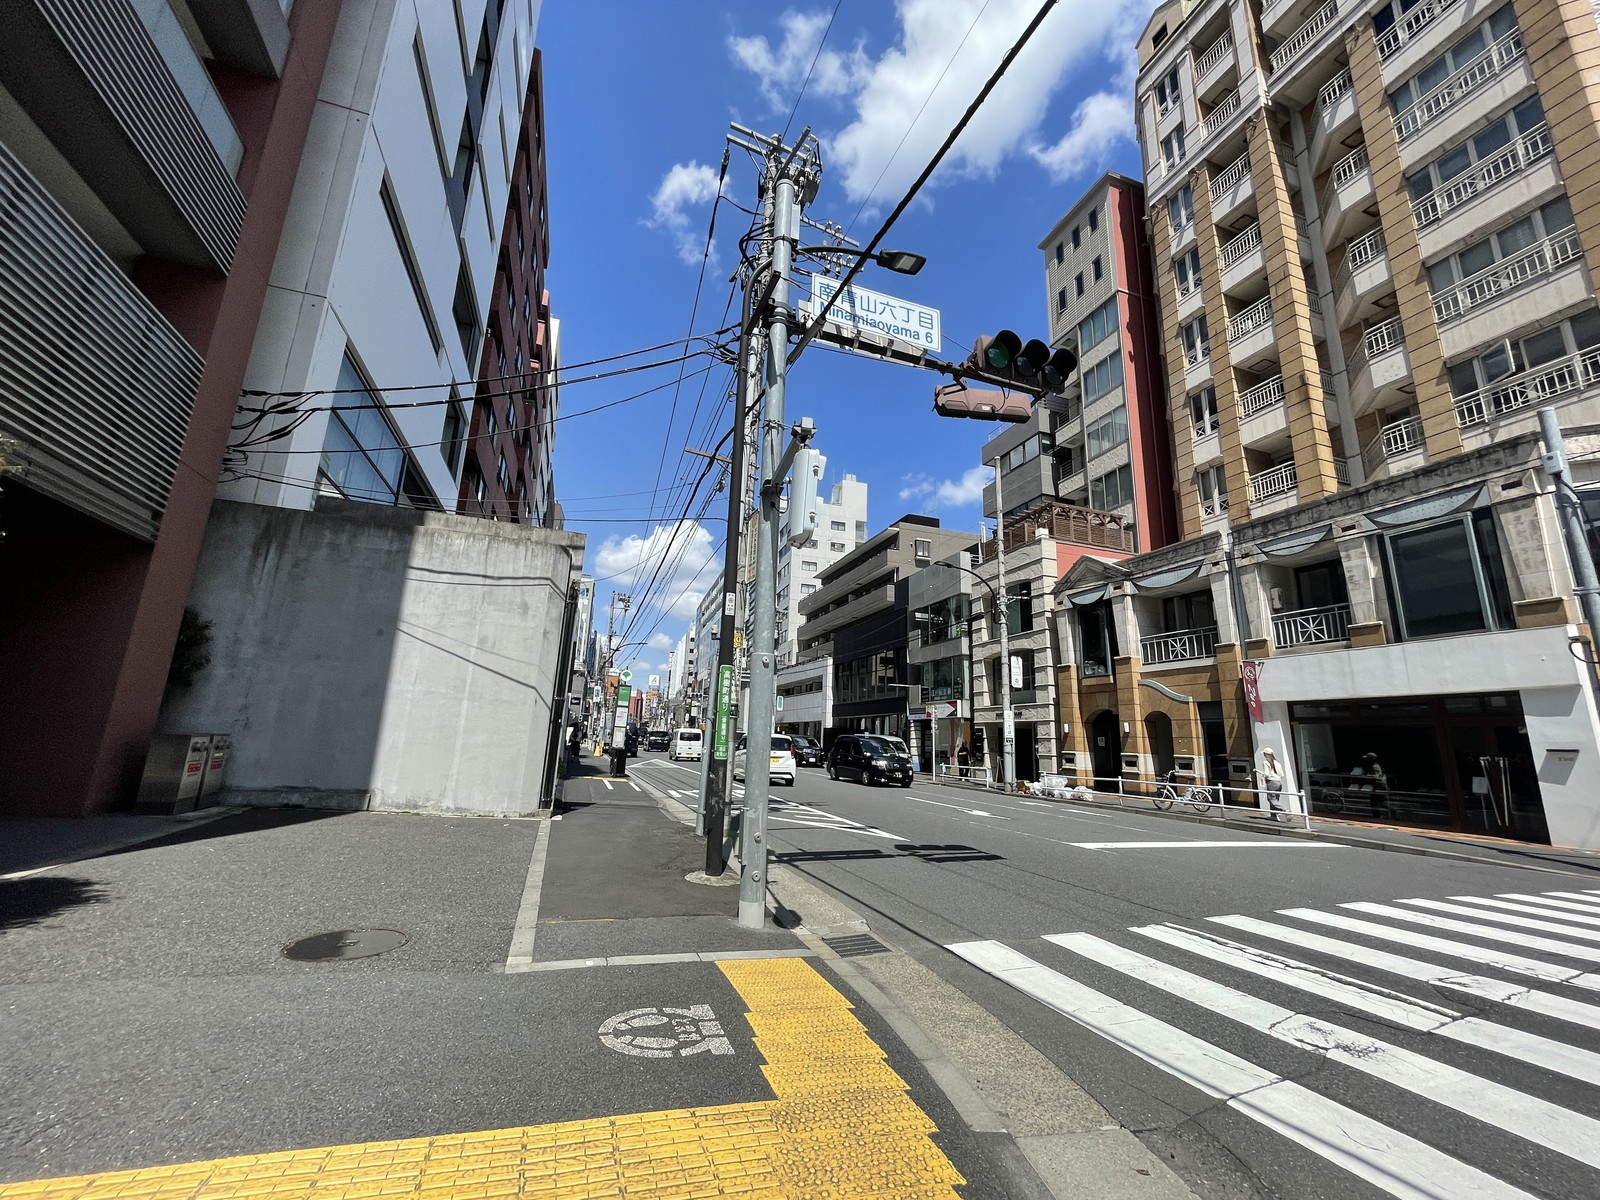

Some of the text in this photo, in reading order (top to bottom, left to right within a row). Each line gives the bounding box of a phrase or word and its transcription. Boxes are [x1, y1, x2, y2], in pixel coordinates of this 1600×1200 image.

[819, 281, 934, 330] 南青山六丁目
[820, 301, 934, 344] Minamiaoyama 6
